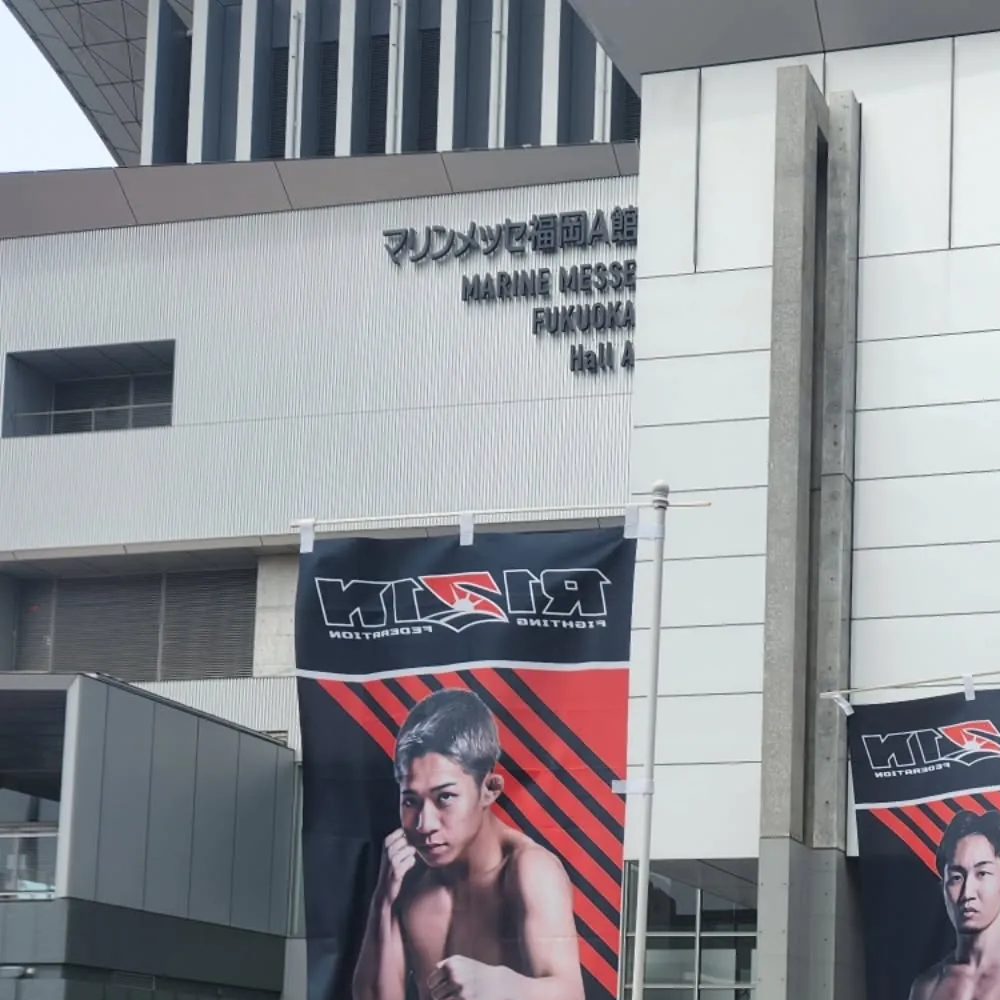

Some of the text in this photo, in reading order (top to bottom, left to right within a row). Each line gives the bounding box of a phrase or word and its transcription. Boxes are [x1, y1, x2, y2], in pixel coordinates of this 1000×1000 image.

[383, 205, 638, 266] マリンメッセ福岡A館
[462, 259, 636, 301] MARINE MESSE
[532, 300, 635, 335] FUKUOKA
[570, 340, 635, 373] Hall A
